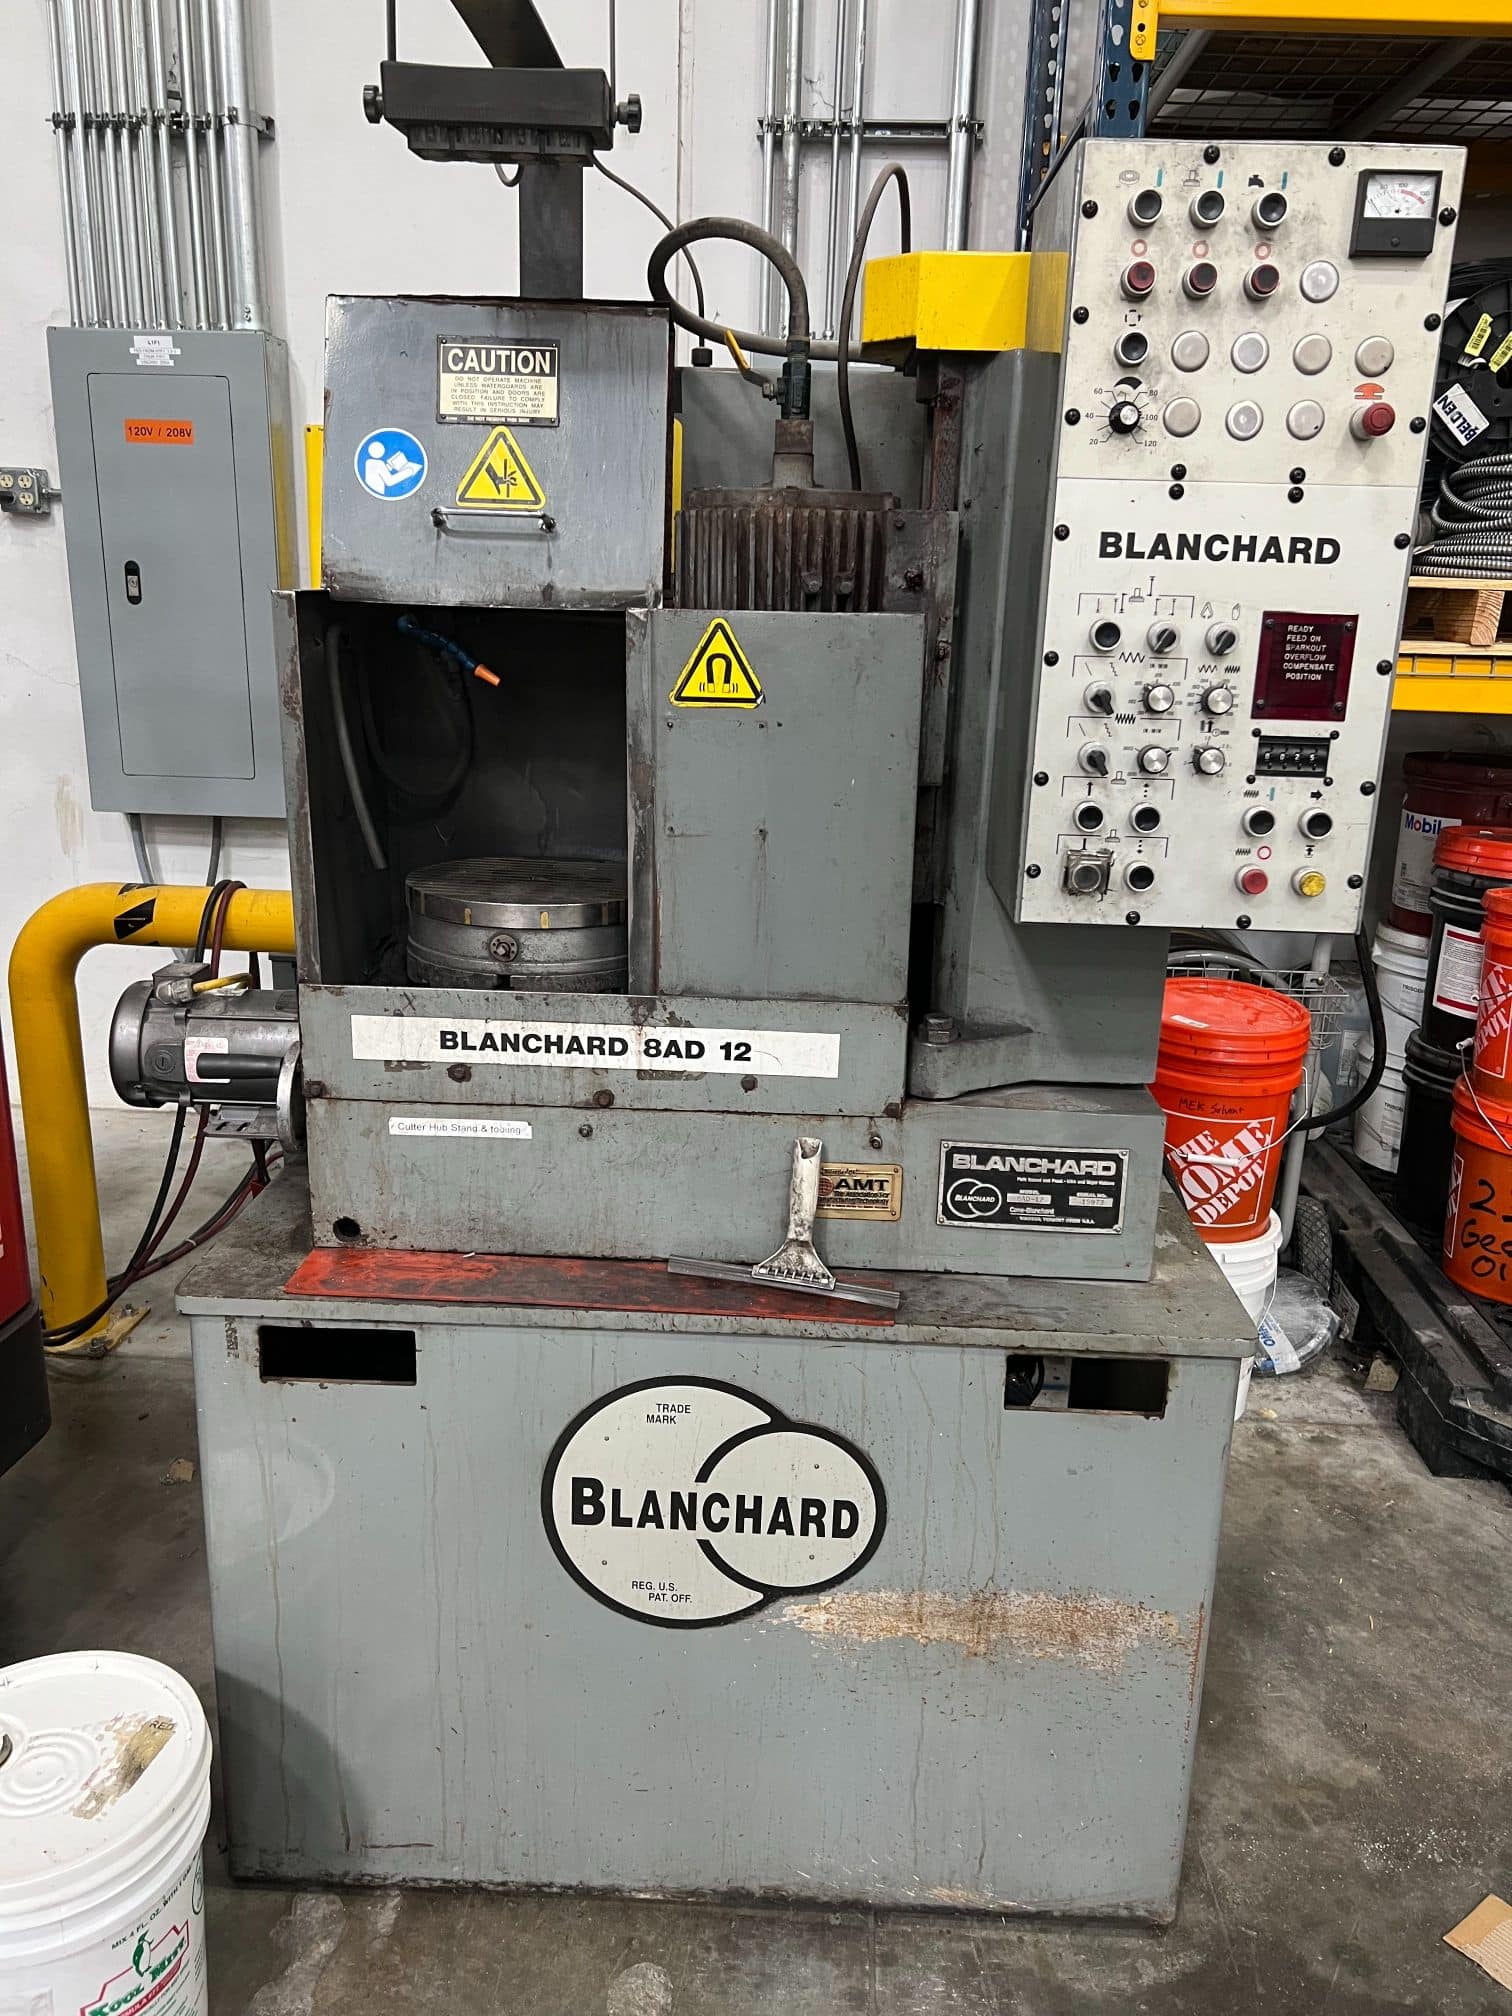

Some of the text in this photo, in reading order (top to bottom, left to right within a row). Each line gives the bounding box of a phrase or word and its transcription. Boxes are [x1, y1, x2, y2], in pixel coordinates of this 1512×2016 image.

[447, 348, 551, 374] CAUTION
[1437, 394, 1478, 442] BELDEN
[128, 426, 153, 437] 120V
[166, 428, 192, 438] 208V
[1089, 438, 1098, 446] 20
[1099, 531, 1342, 565] BLANCHARD
[1287, 624, 1315, 633] READY
[1286, 634, 1308, 642] FEED
[1285, 644, 1328, 652] SPARKOUT
[1284, 653, 1328, 661] OVERFLOW
[1282, 662, 1336, 671] COMPENSATE
[1285, 672, 1322, 681] POSITION
[1405, 812, 1442, 835] Mobil
[439, 1030, 752, 1062] BLANCHARD 8AD 12
[398, 1122, 425, 1132] Cutter
[429, 1123, 448, 1132] Hub
[451, 1124, 478, 1133] Stand
[480, 1124, 488, 1133] &
[952, 1153, 1117, 1177] BLANCHARD
[834, 1178, 889, 1191] AMT
[1194, 1159, 1264, 1225] DEPOT
[954, 1194, 996, 1203] BLANCHARD
[656, 1403, 691, 1414] TRADE
[646, 1414, 677, 1425] MARK
[571, 1476, 860, 1539] BLANCHARD
[631, 1580, 678, 1592] REG. U.S.
[648, 1592, 693, 1604] PAT. OFF.
[111, 1936, 128, 1950] MIX
